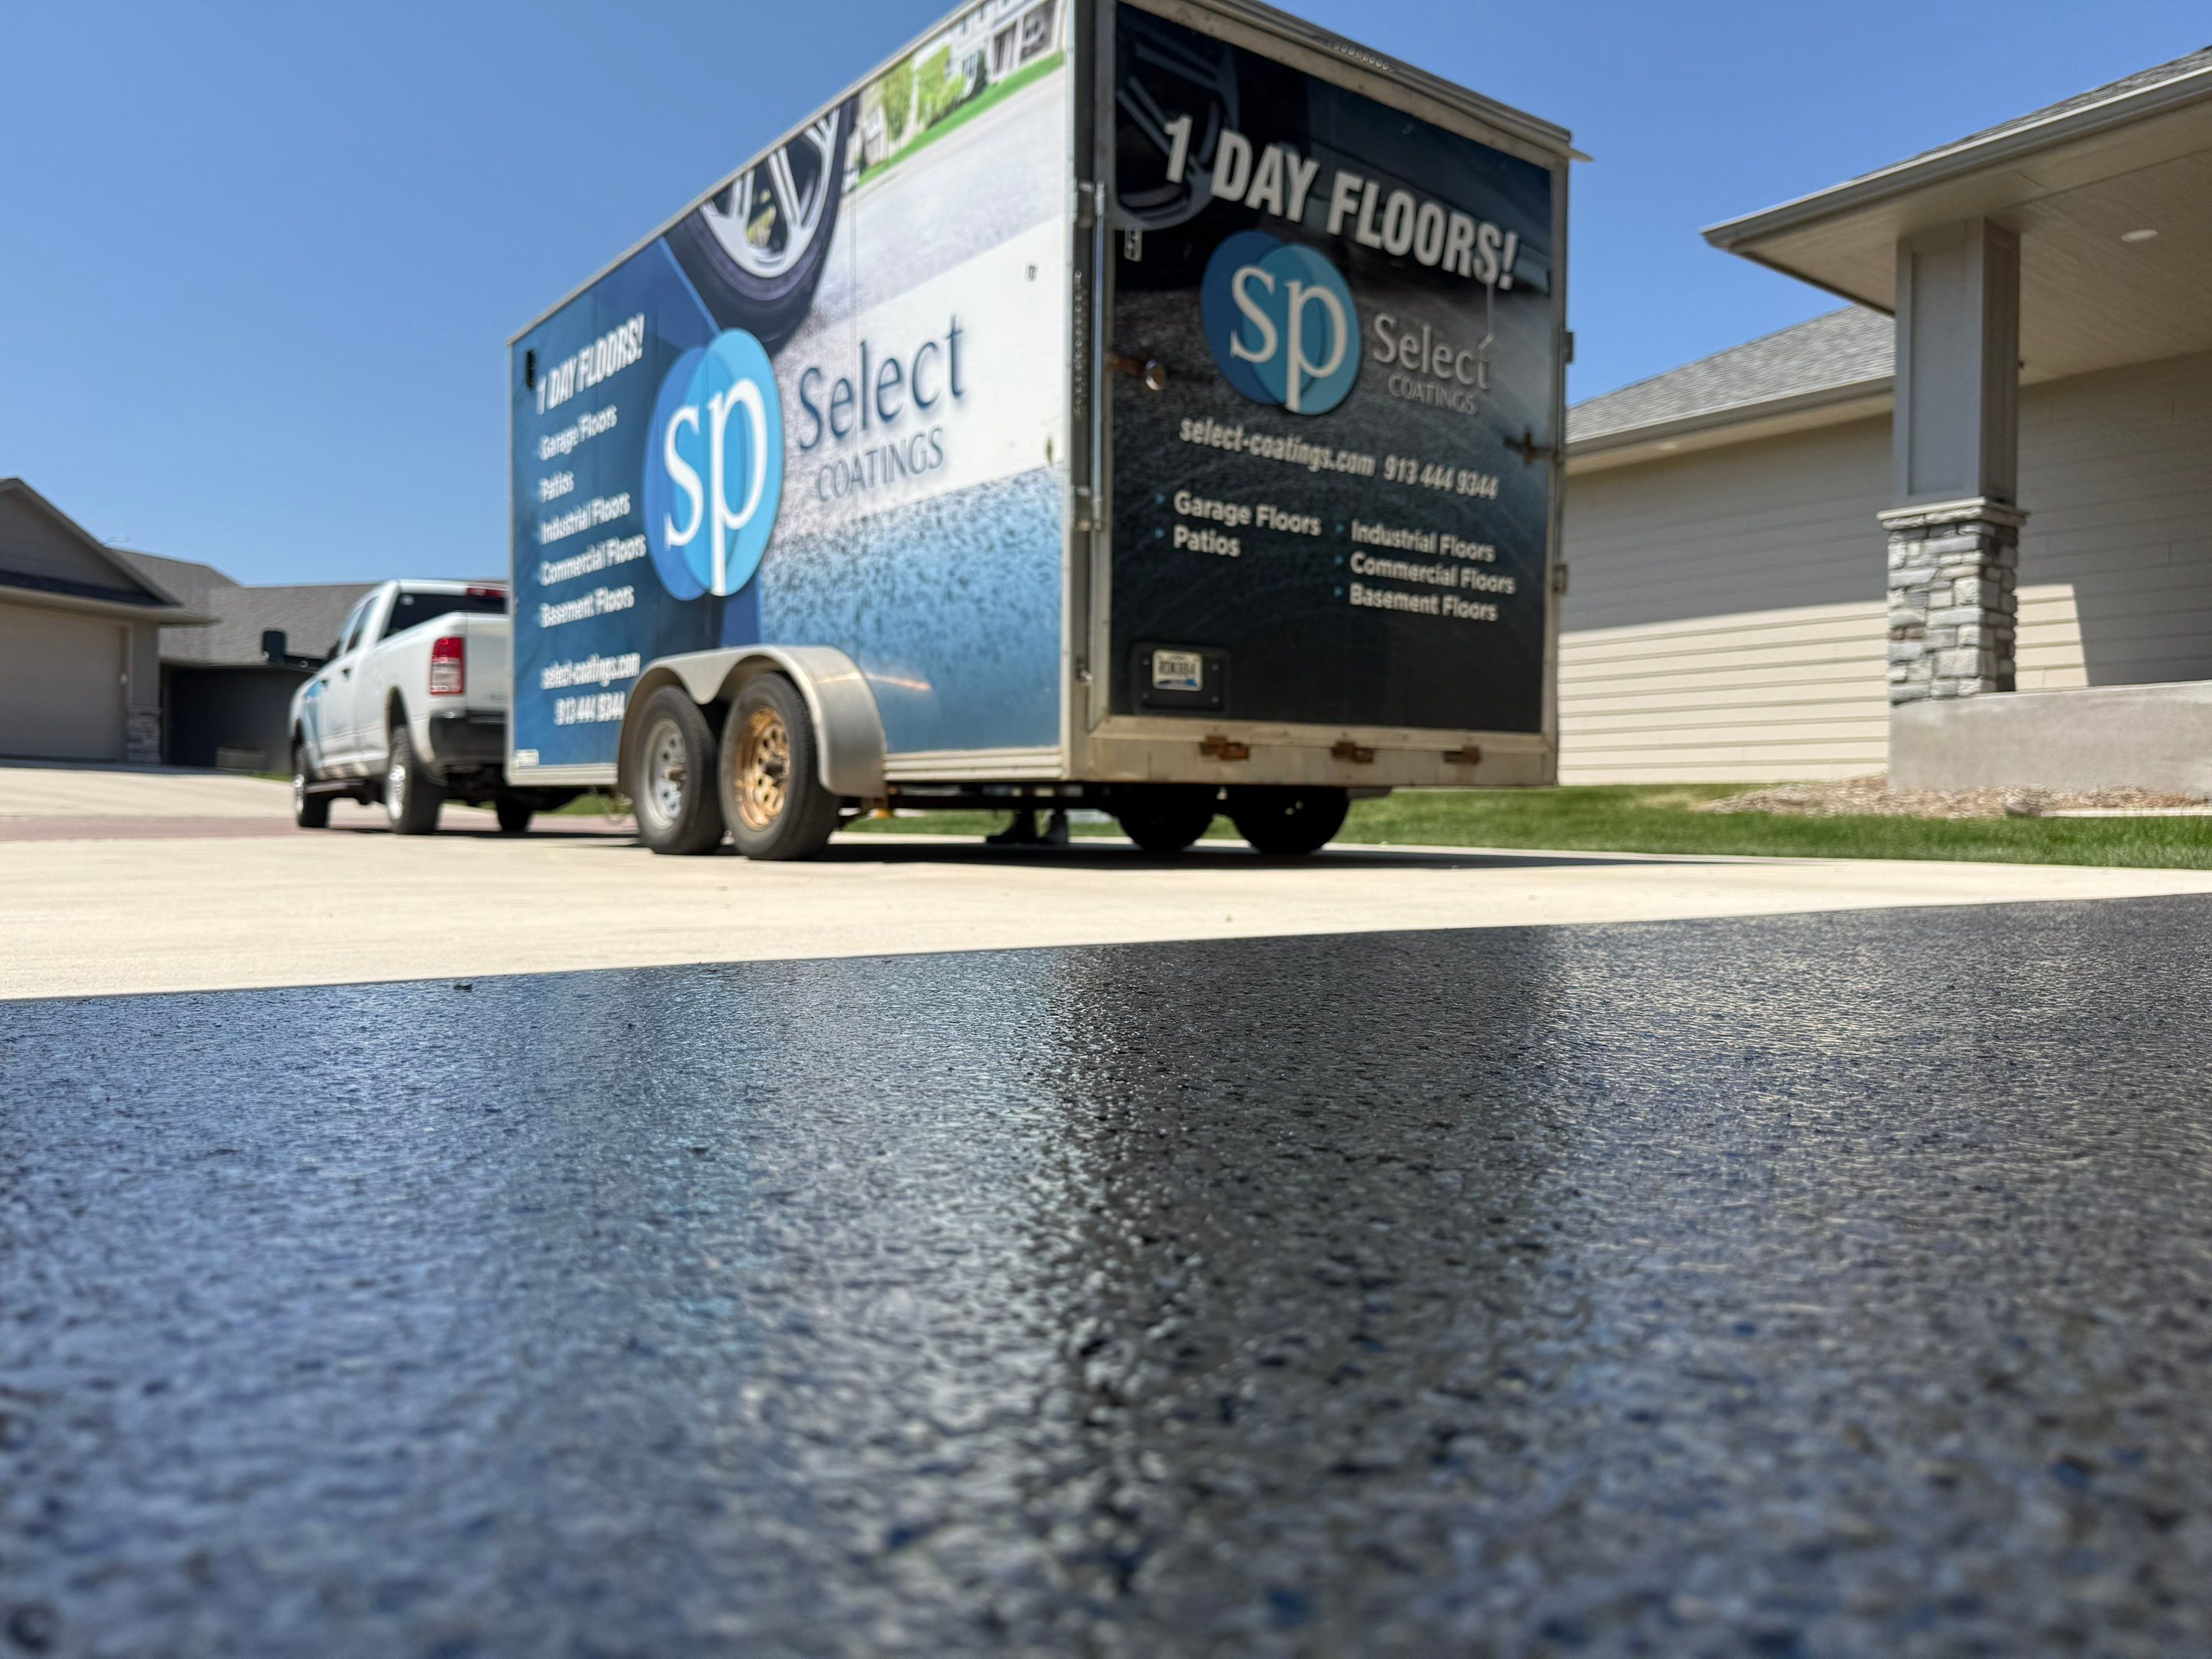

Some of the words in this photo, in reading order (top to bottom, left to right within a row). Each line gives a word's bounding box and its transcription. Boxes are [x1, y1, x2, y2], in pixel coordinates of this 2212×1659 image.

[1164, 114, 1193, 184] 1
[1210, 127, 1320, 223] DAY
[1326, 169, 1518, 290] FLOORS!
[537, 375, 546, 415] 1
[546, 356, 578, 409] DAY
[577, 313, 645, 392] FLOORS!
[1230, 265, 1347, 412] sp
[1373, 313, 1492, 389] Select
[798, 311, 967, 452] Select
[1388, 373, 1478, 416] COATINGS
[540, 426, 578, 460] Garage
[578, 404, 618, 442] Floors
[1179, 416, 1376, 477] select-coatings.com
[1384, 453, 1419, 485] 913
[1419, 464, 1455, 493] 444
[1455, 469, 1499, 501] 9344
[539, 471, 575, 503] Patios
[664, 378, 767, 597] sp
[817, 426, 945, 503] COATINGS
[540, 502, 591, 545] Industrial
[590, 492, 631, 526] Floors
[1173, 491, 1251, 527] Garage
[1256, 504, 1322, 537] Floors
[540, 541, 605, 586] Commercial
[605, 533, 647, 567] Floors
[1173, 525, 1240, 558] Patios
[1350, 519, 1438, 555] Industrial
[1439, 532, 1496, 563] Floors
[1349, 551, 1456, 588] Commercial
[1460, 566, 1516, 594] Floors
[540, 591, 594, 628] Basement
[594, 585, 635, 614] Floors
[1349, 583, 1439, 615] Basement
[1442, 596, 1498, 621] Floors
